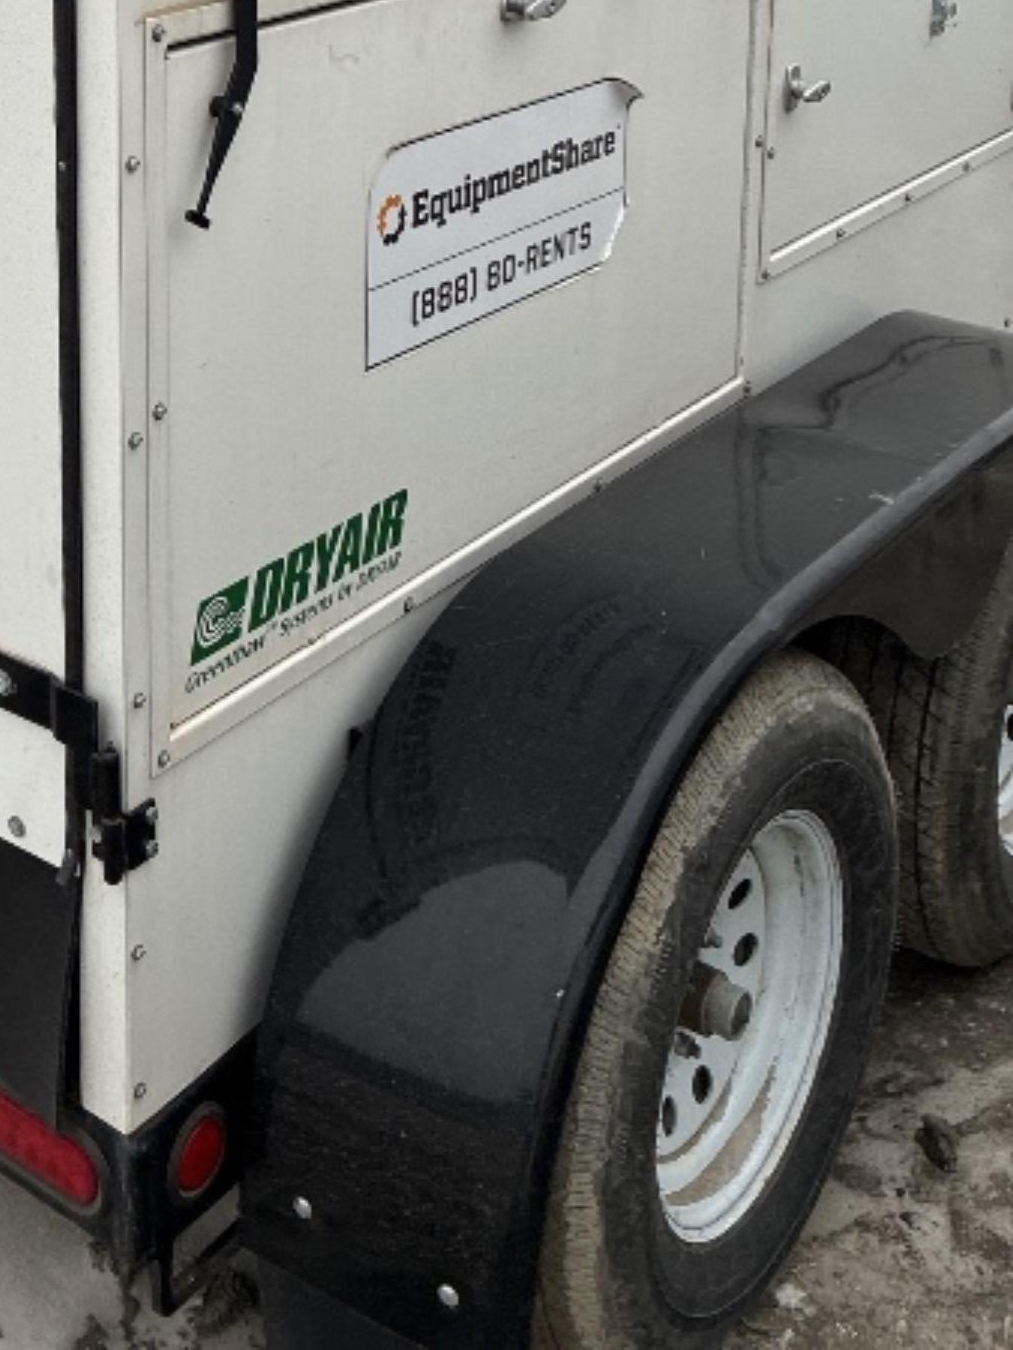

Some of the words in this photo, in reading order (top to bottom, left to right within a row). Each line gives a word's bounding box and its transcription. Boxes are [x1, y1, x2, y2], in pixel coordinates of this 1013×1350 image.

[412, 130, 616, 228] EquipmentShare
[410, 266, 478, 327] (888)
[248, 489, 408, 634] DRYAIR
